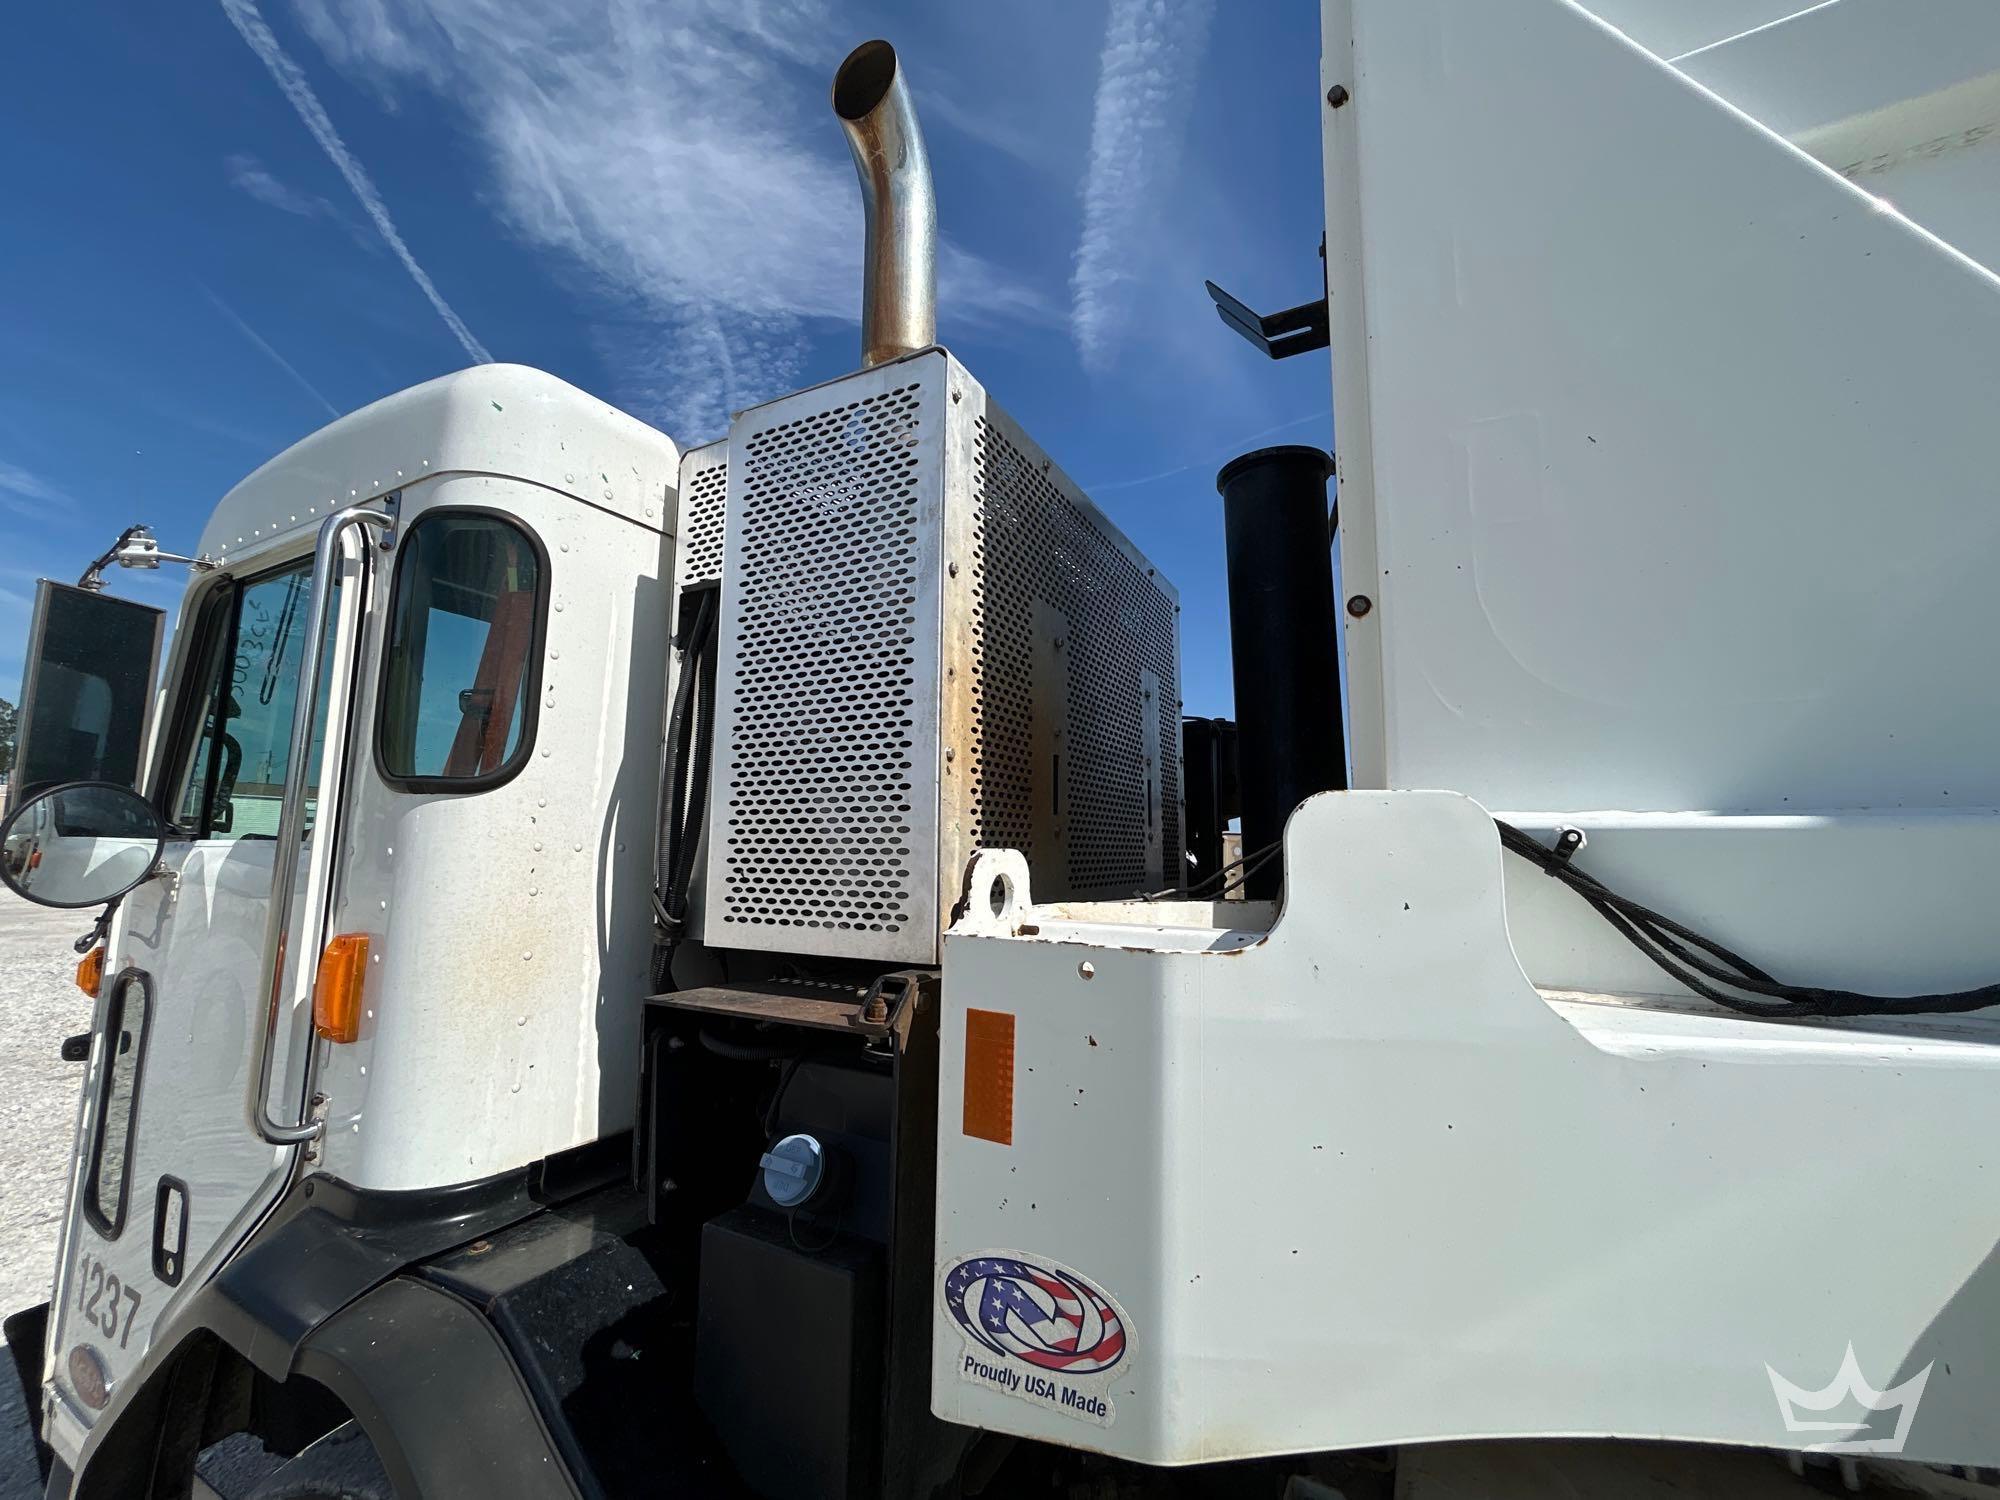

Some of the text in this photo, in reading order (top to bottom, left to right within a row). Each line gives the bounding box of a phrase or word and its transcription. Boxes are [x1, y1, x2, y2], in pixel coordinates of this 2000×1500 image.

[79, 1252, 141, 1350] 1237
[964, 1355, 1107, 1417] Proudly USA Made
